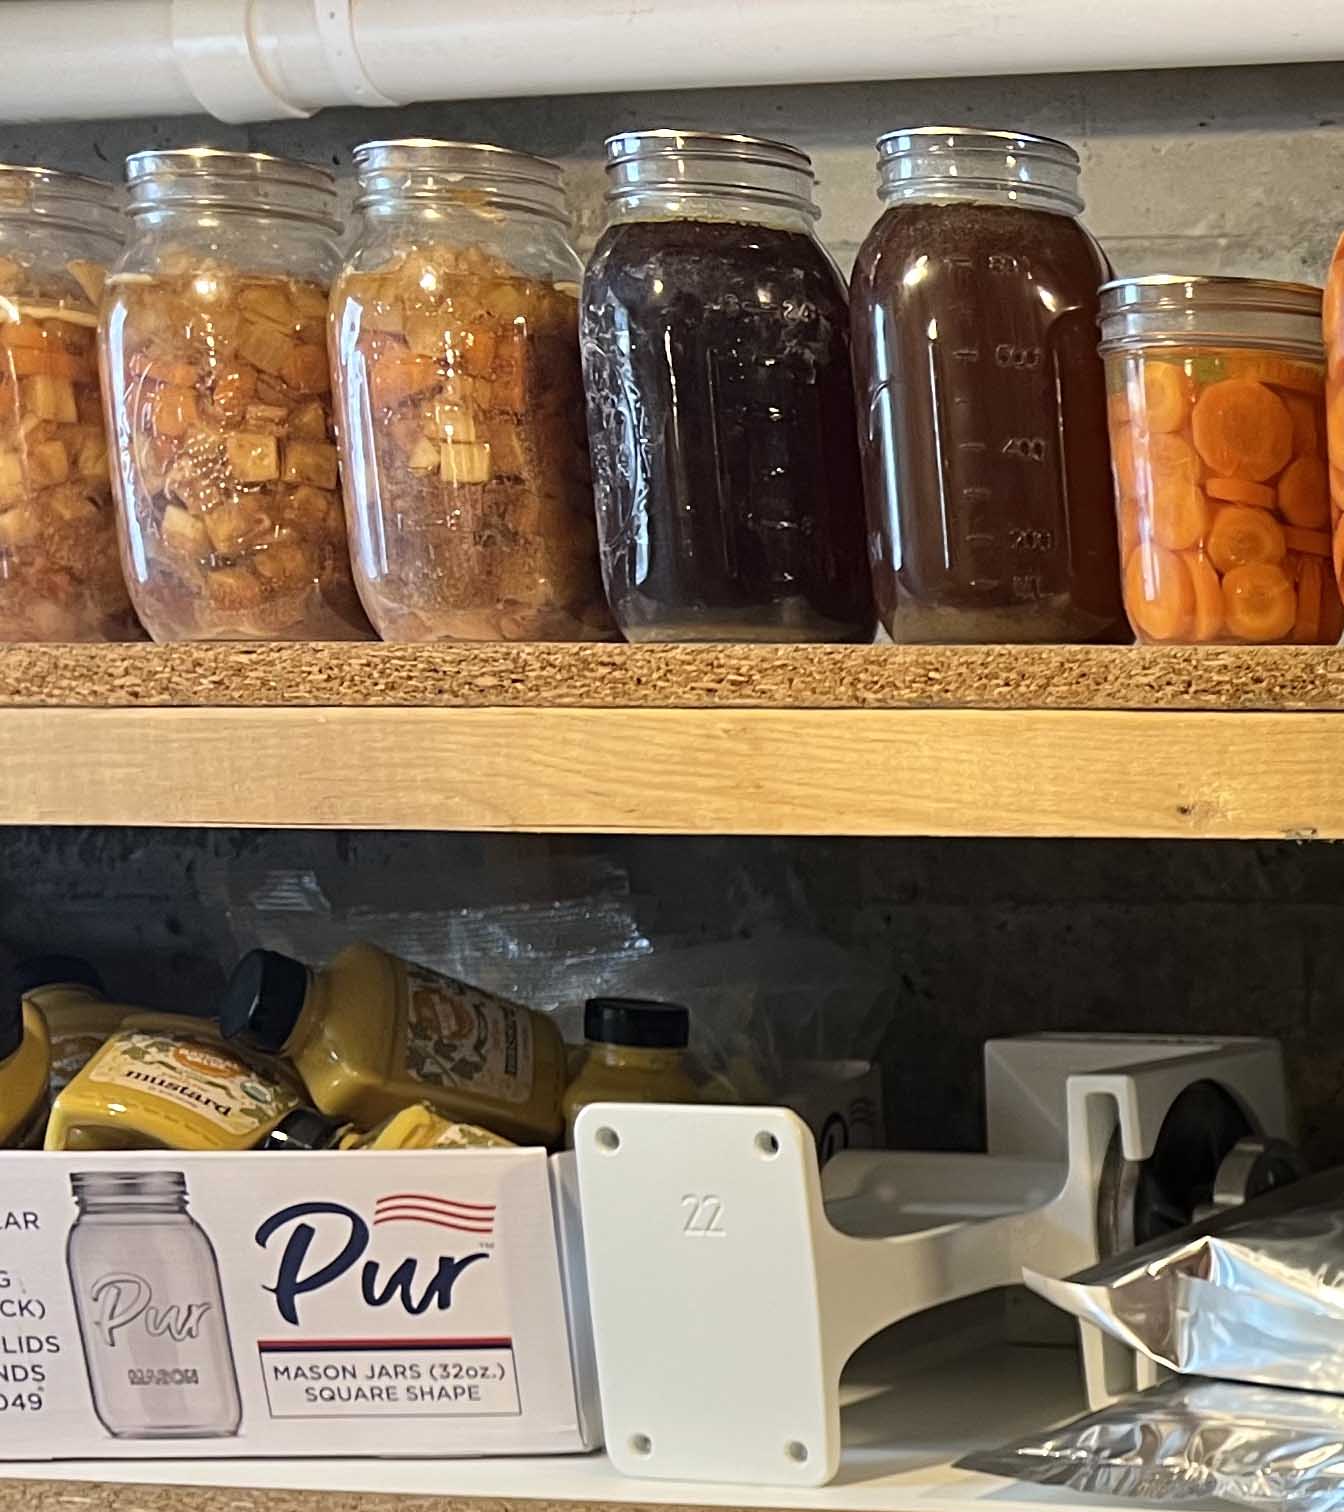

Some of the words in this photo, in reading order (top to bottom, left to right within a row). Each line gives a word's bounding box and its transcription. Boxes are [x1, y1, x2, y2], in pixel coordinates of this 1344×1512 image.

[125, 1069, 232, 1118] mustard
[0, 1211, 40, 1230] AR
[681, 1193, 727, 1238] 22
[255, 1201, 490, 1326] Pur
[91, 1272, 213, 1347] Pur
[1, 1335, 61, 1354] LIDS
[273, 1364, 357, 1381] MASON
[366, 1364, 422, 1381] JARS
[304, 1385, 399, 1402] SQUARE
[406, 1385, 482, 1401] SHAPE
